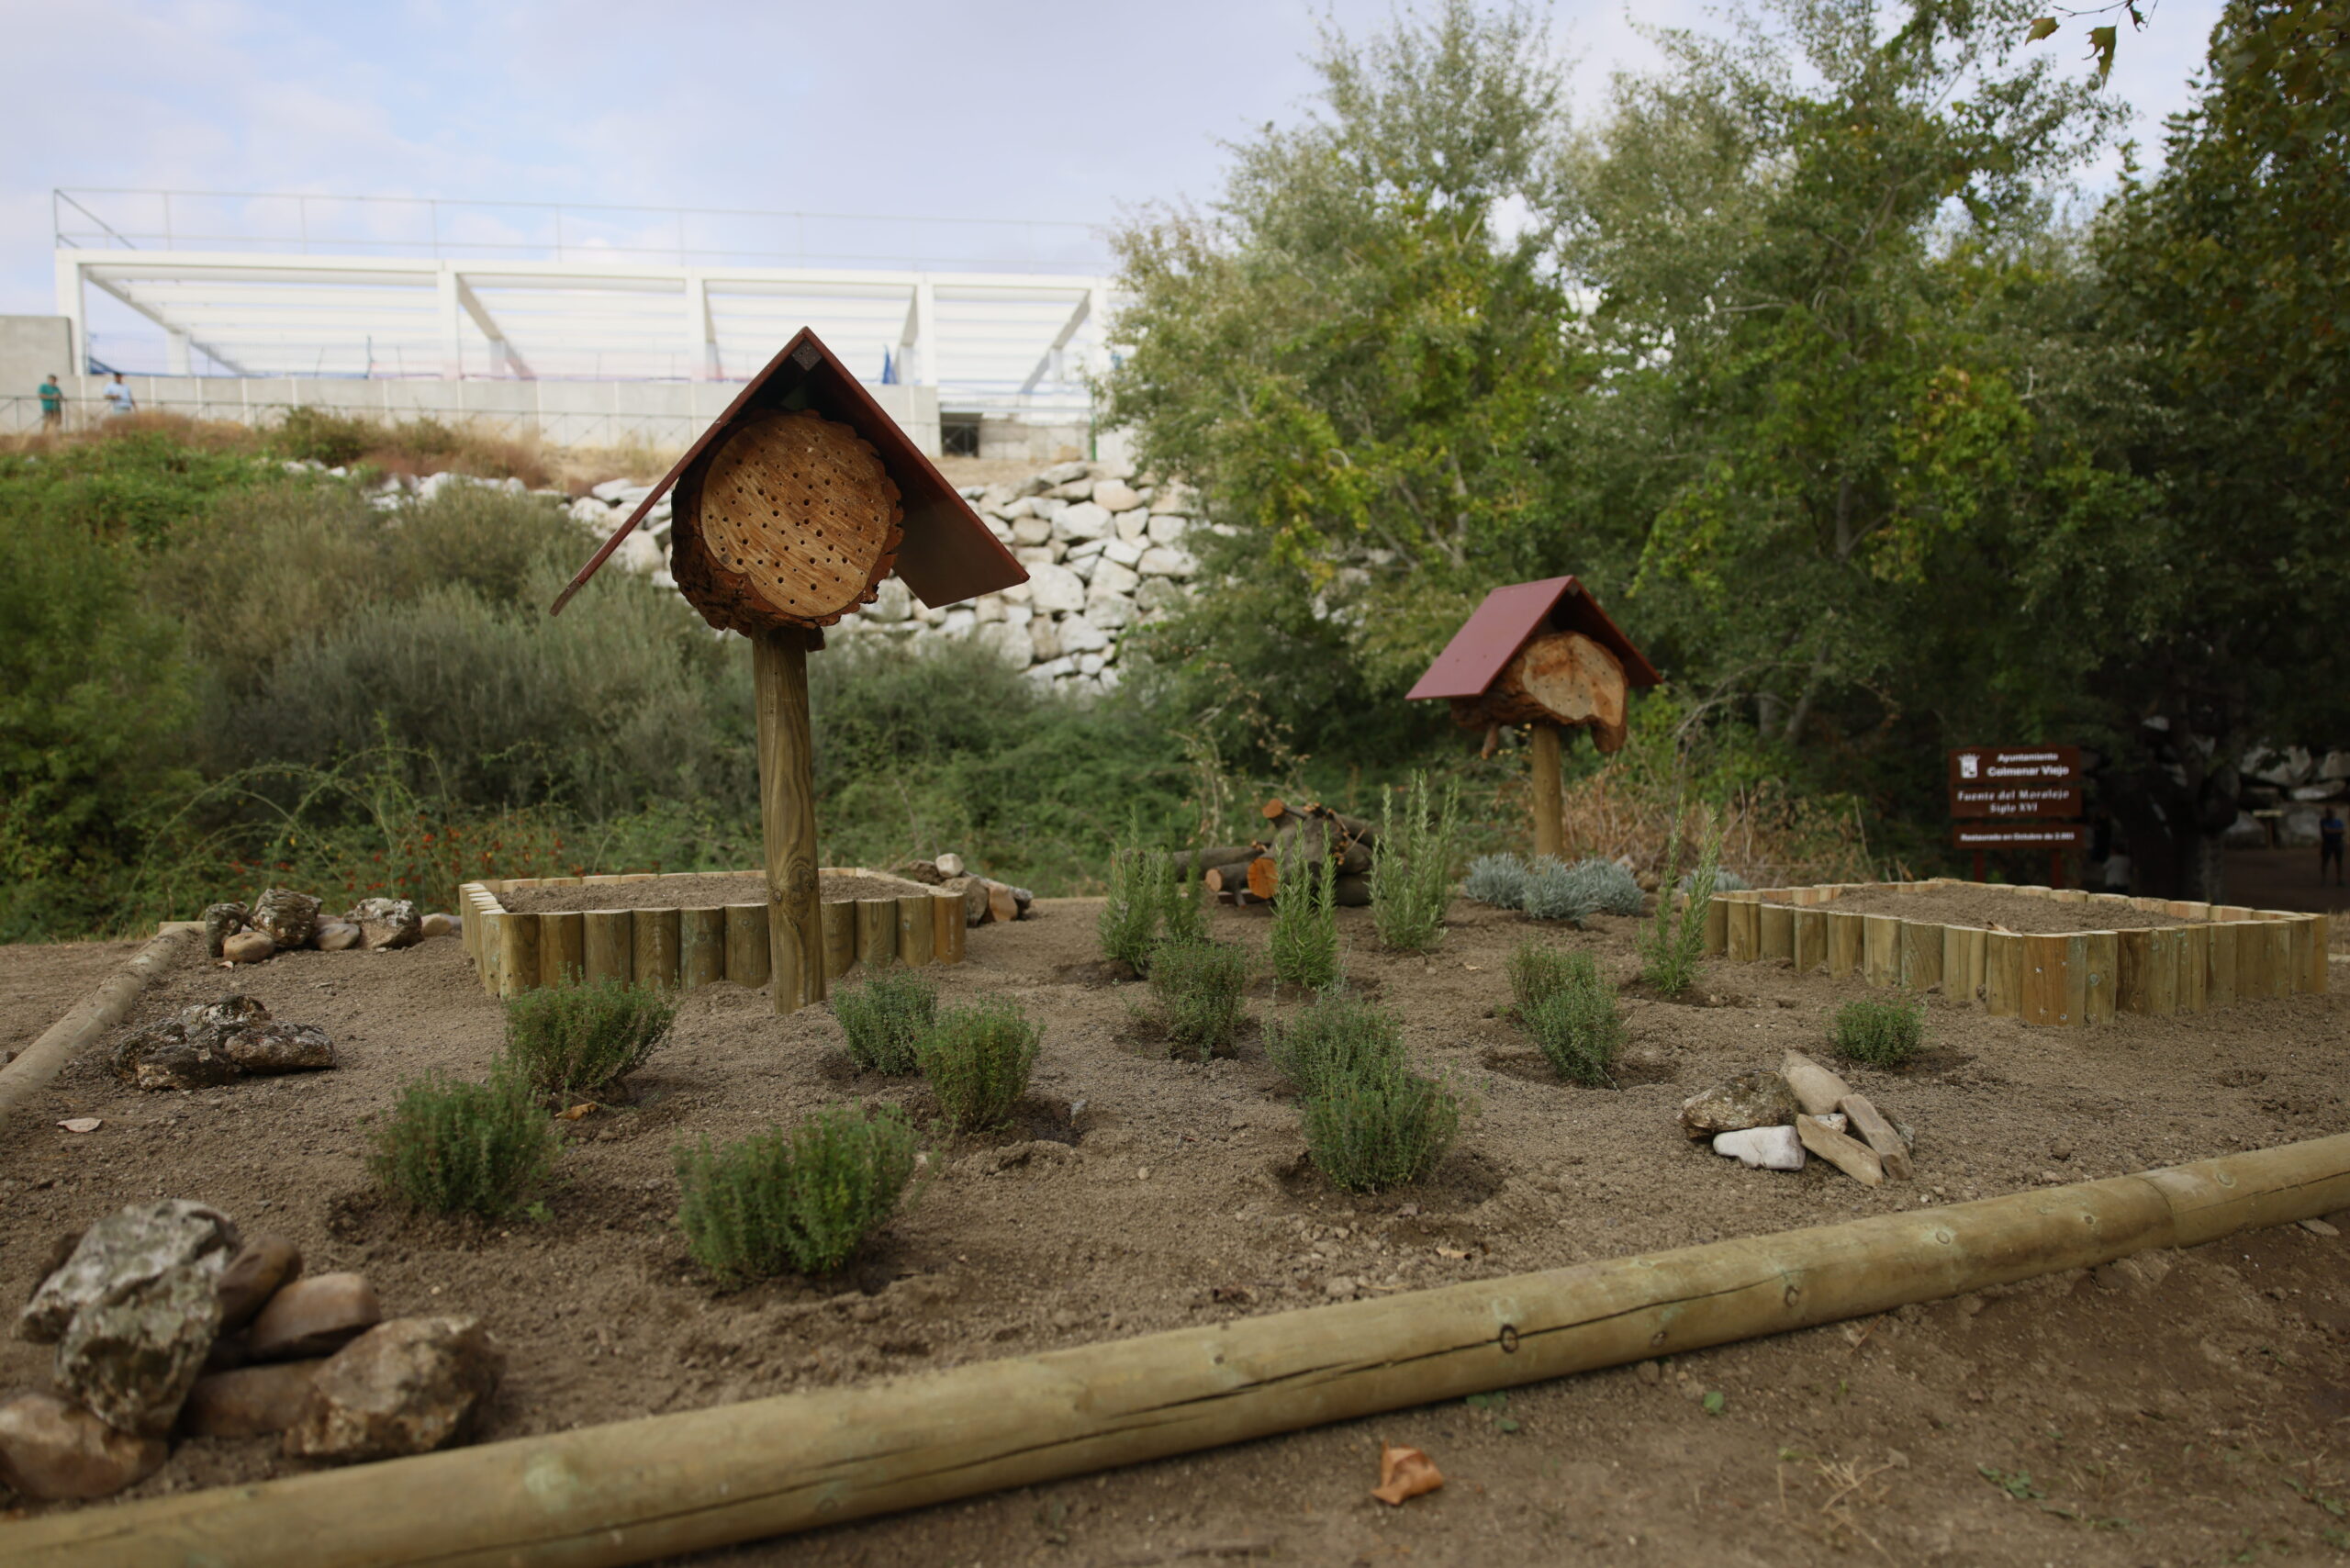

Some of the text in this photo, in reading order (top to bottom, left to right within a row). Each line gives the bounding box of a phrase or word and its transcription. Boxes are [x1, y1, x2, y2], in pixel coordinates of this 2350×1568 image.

[1997, 753, 2059, 764] Ayuntamiento
[1986, 765, 2070, 778] Colmenar Viejo
[1957, 790, 1995, 801] Fuente
[1997, 790, 2016, 800] del
[1989, 801, 2038, 815] Siglo XVI
